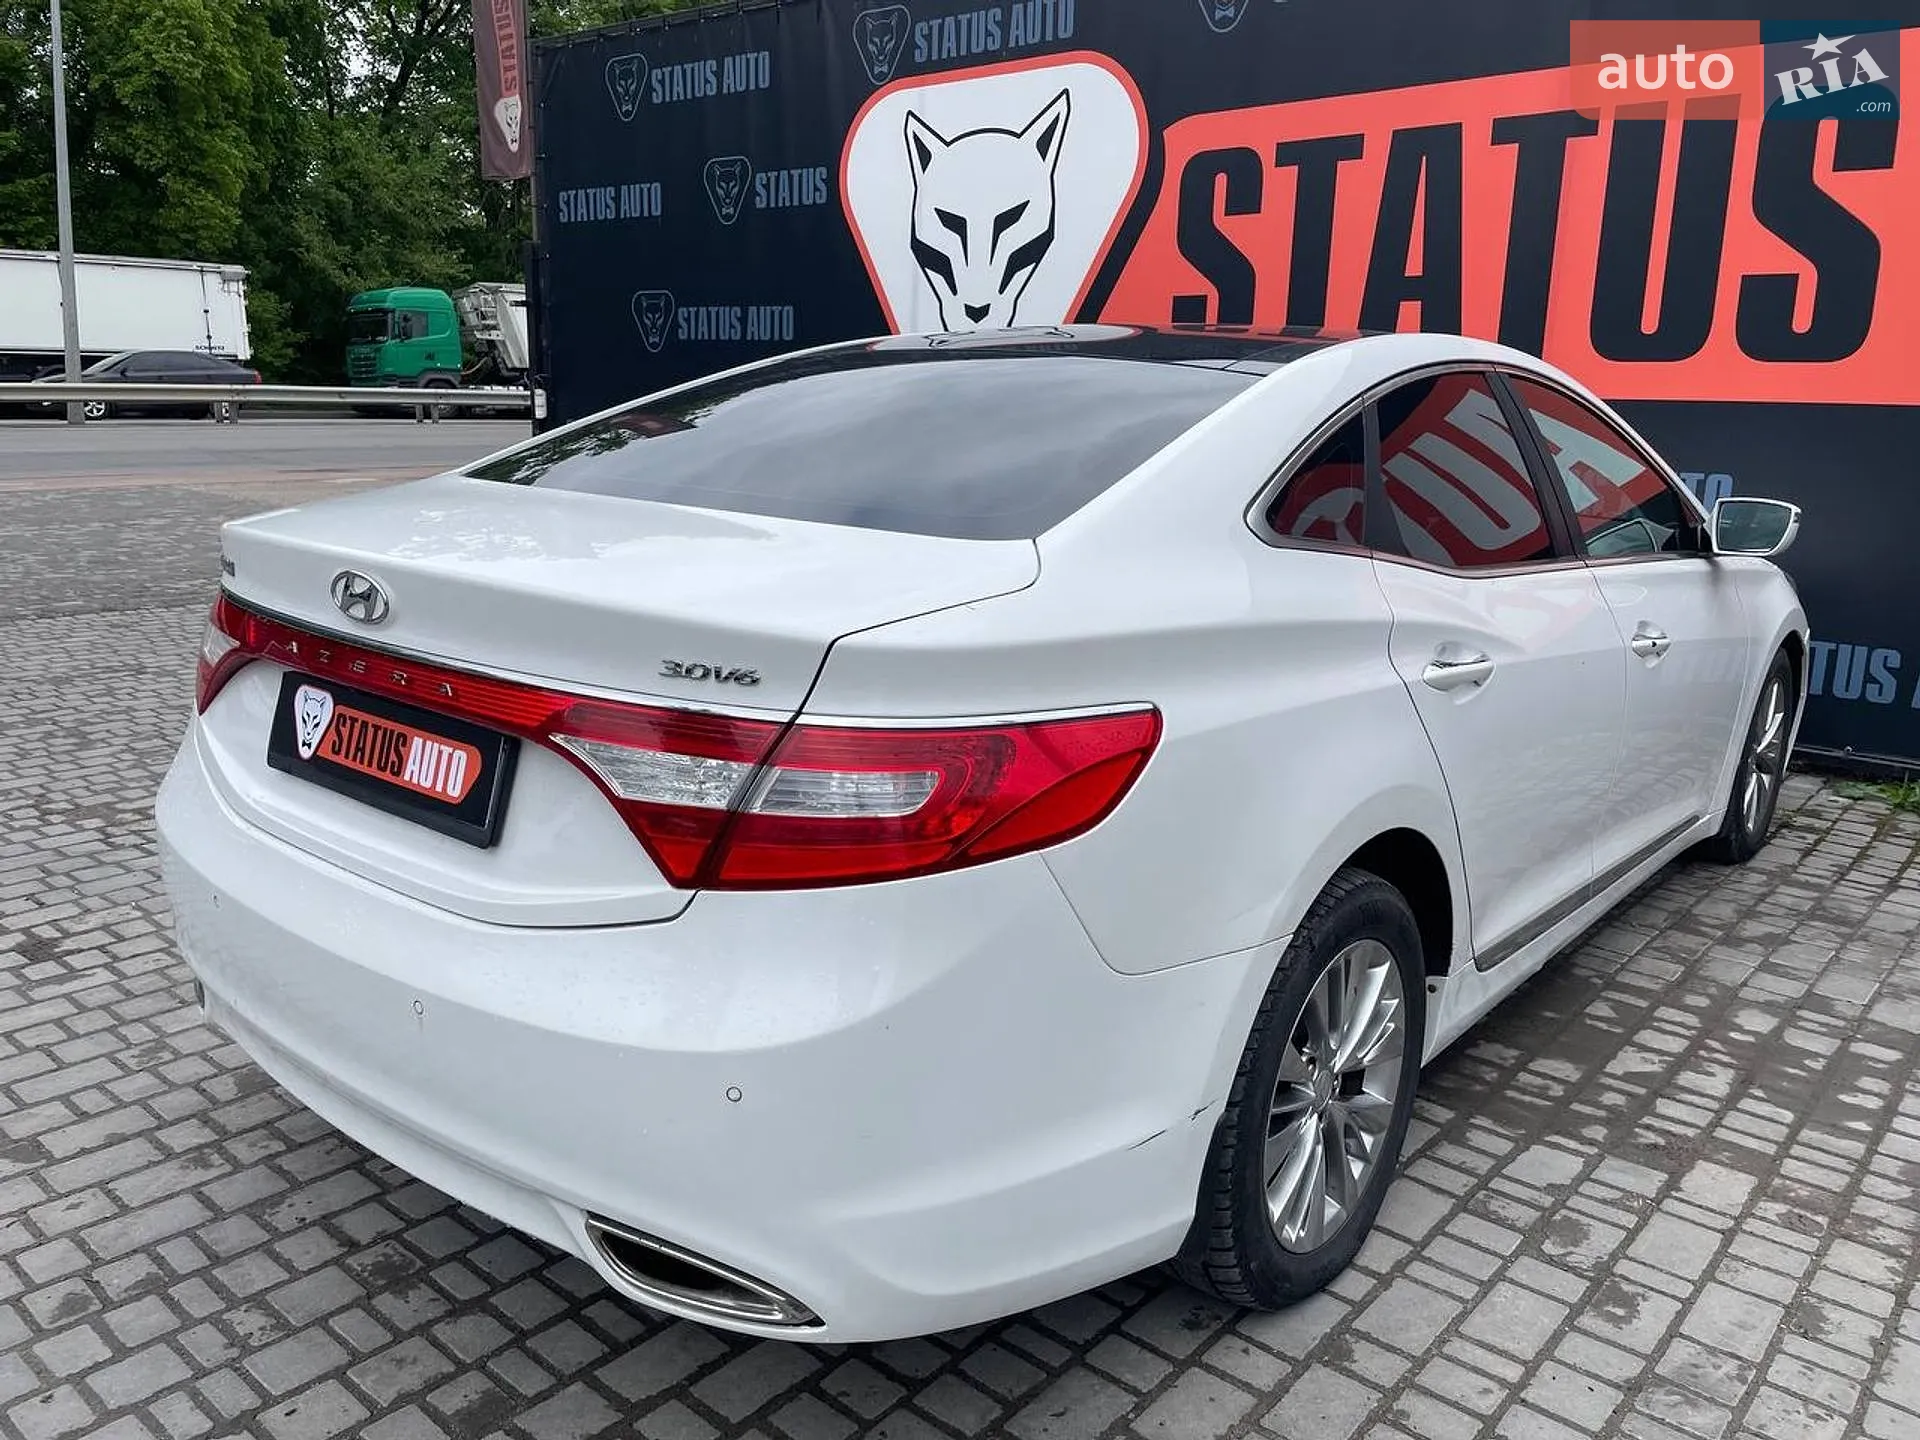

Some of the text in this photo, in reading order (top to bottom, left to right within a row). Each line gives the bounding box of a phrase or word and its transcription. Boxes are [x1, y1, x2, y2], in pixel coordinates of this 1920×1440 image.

[914, 0, 1075, 63] STATUS AUTO
[651, 51, 770, 104] STATUS AUTO
[558, 181, 662, 223] STATUS AUTO
[755, 166, 829, 209] STATUS
[1171, 84, 1900, 362] STATUS
[677, 305, 794, 341] STATUS AUTO
[285, 640, 453, 697] AZERA
[331, 712, 468, 798] STATUS AUTO
